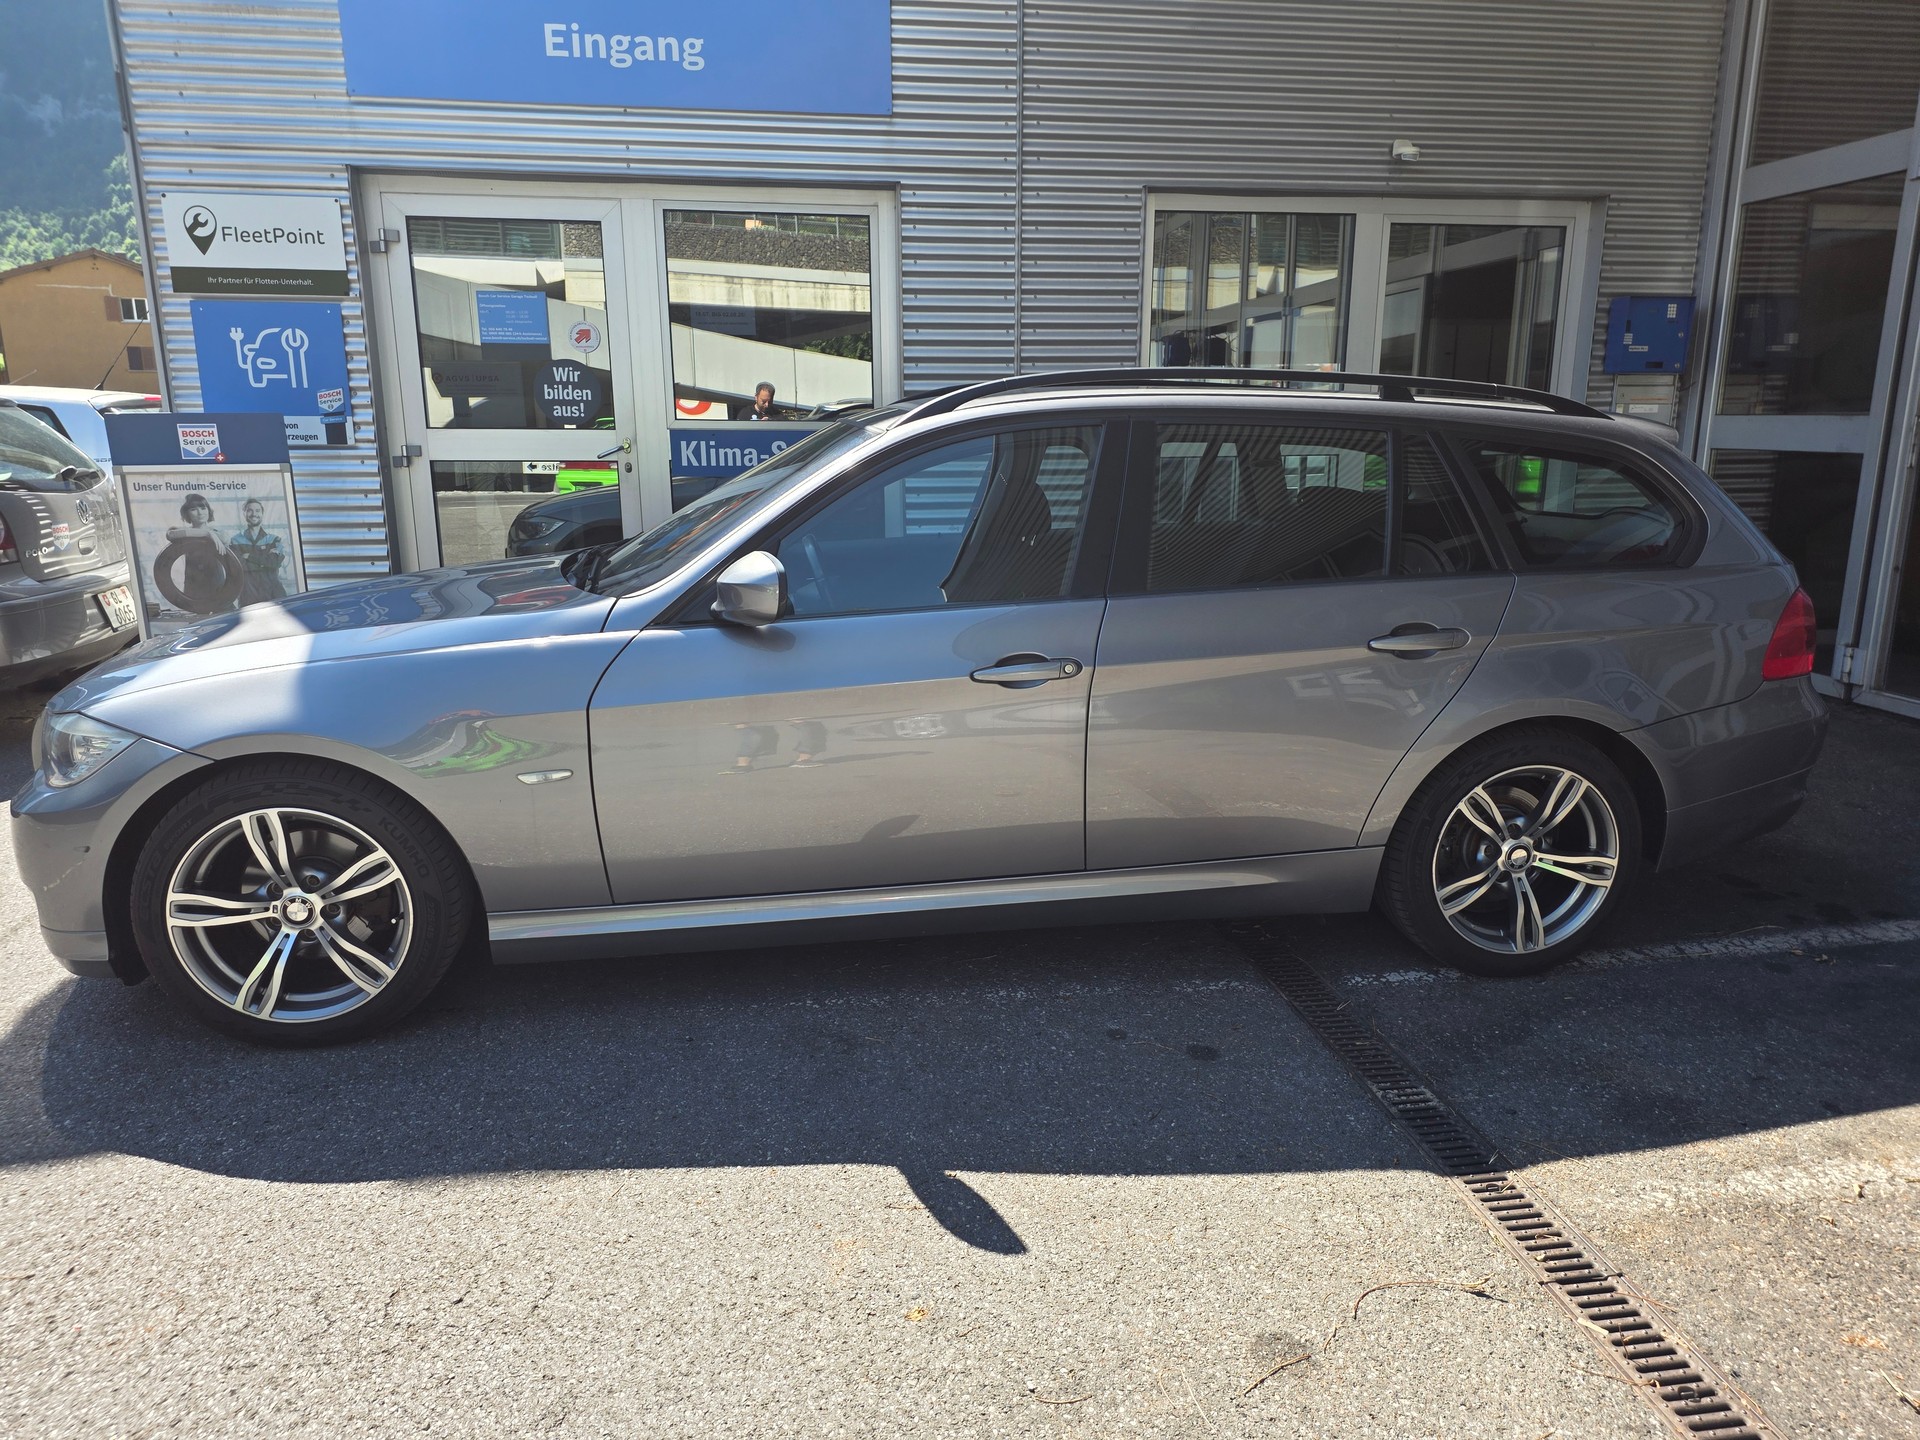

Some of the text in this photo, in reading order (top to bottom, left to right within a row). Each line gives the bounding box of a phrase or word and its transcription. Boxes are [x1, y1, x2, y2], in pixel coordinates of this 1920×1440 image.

[544, 22, 705, 71] Eingang
[221, 226, 326, 245] FleetPoint
[255, 278, 314, 286] Flotten-Unterhalt.
[552, 366, 580, 382] Wir
[318, 390, 342, 399] BOSCH
[544, 384, 592, 400] bilden
[553, 402, 584, 417] aus!
[182, 430, 214, 438] BOSCH
[133, 480, 246, 491] Unser Rundum-Service
[52, 525, 68, 534] BOSCH
[110, 591, 122, 604] GL
[114, 604, 135, 624] 6065
[378, 816, 430, 879] KUMHO
